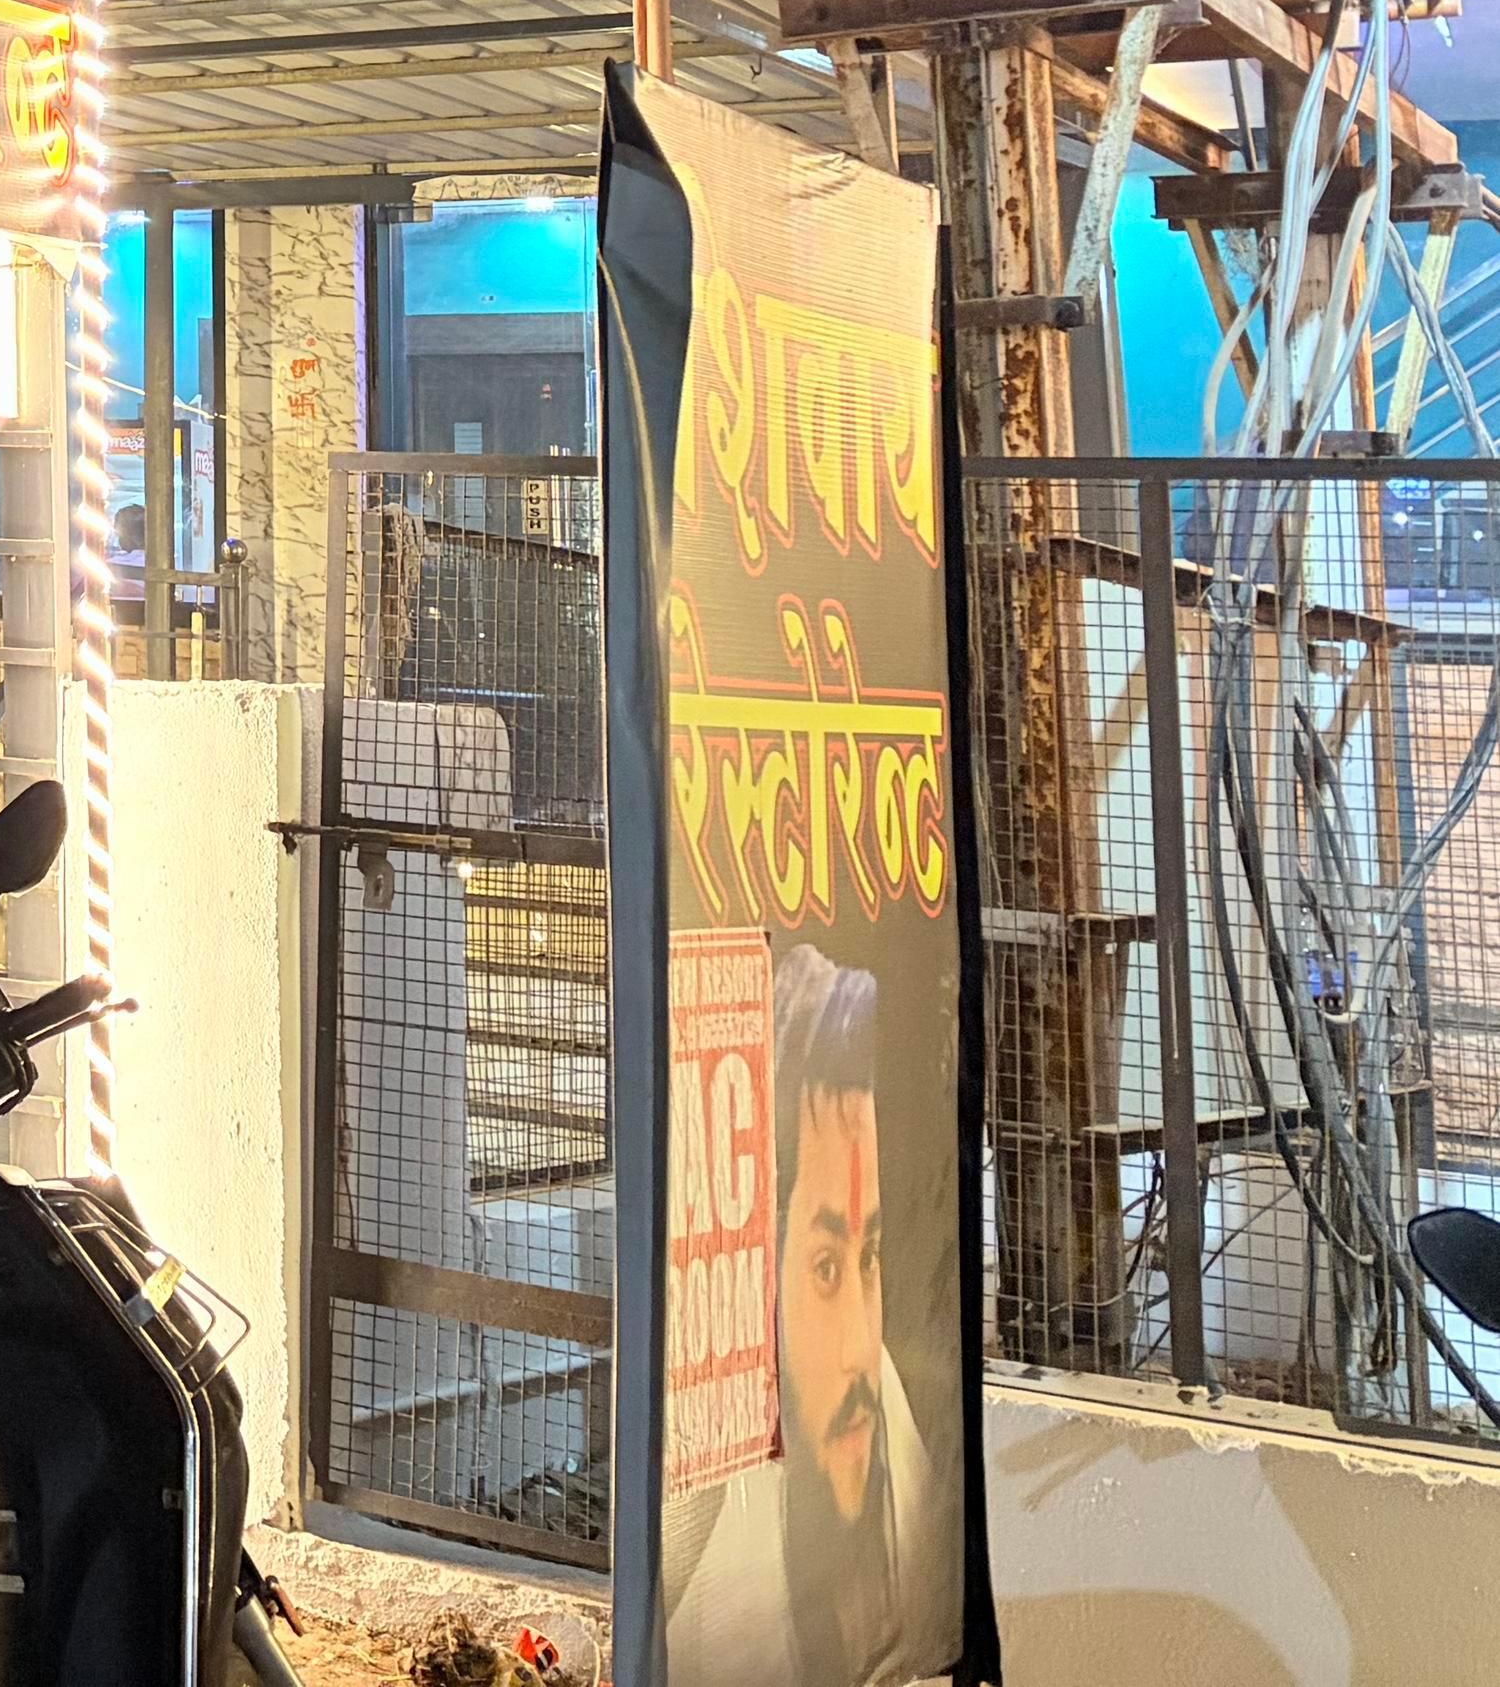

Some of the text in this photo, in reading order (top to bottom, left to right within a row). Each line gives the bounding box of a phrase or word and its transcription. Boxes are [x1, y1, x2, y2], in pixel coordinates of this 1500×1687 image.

[673, 159, 940, 574] शिवाय
[529, 483, 541, 529] PUSH
[669, 1053, 755, 1239] AC
